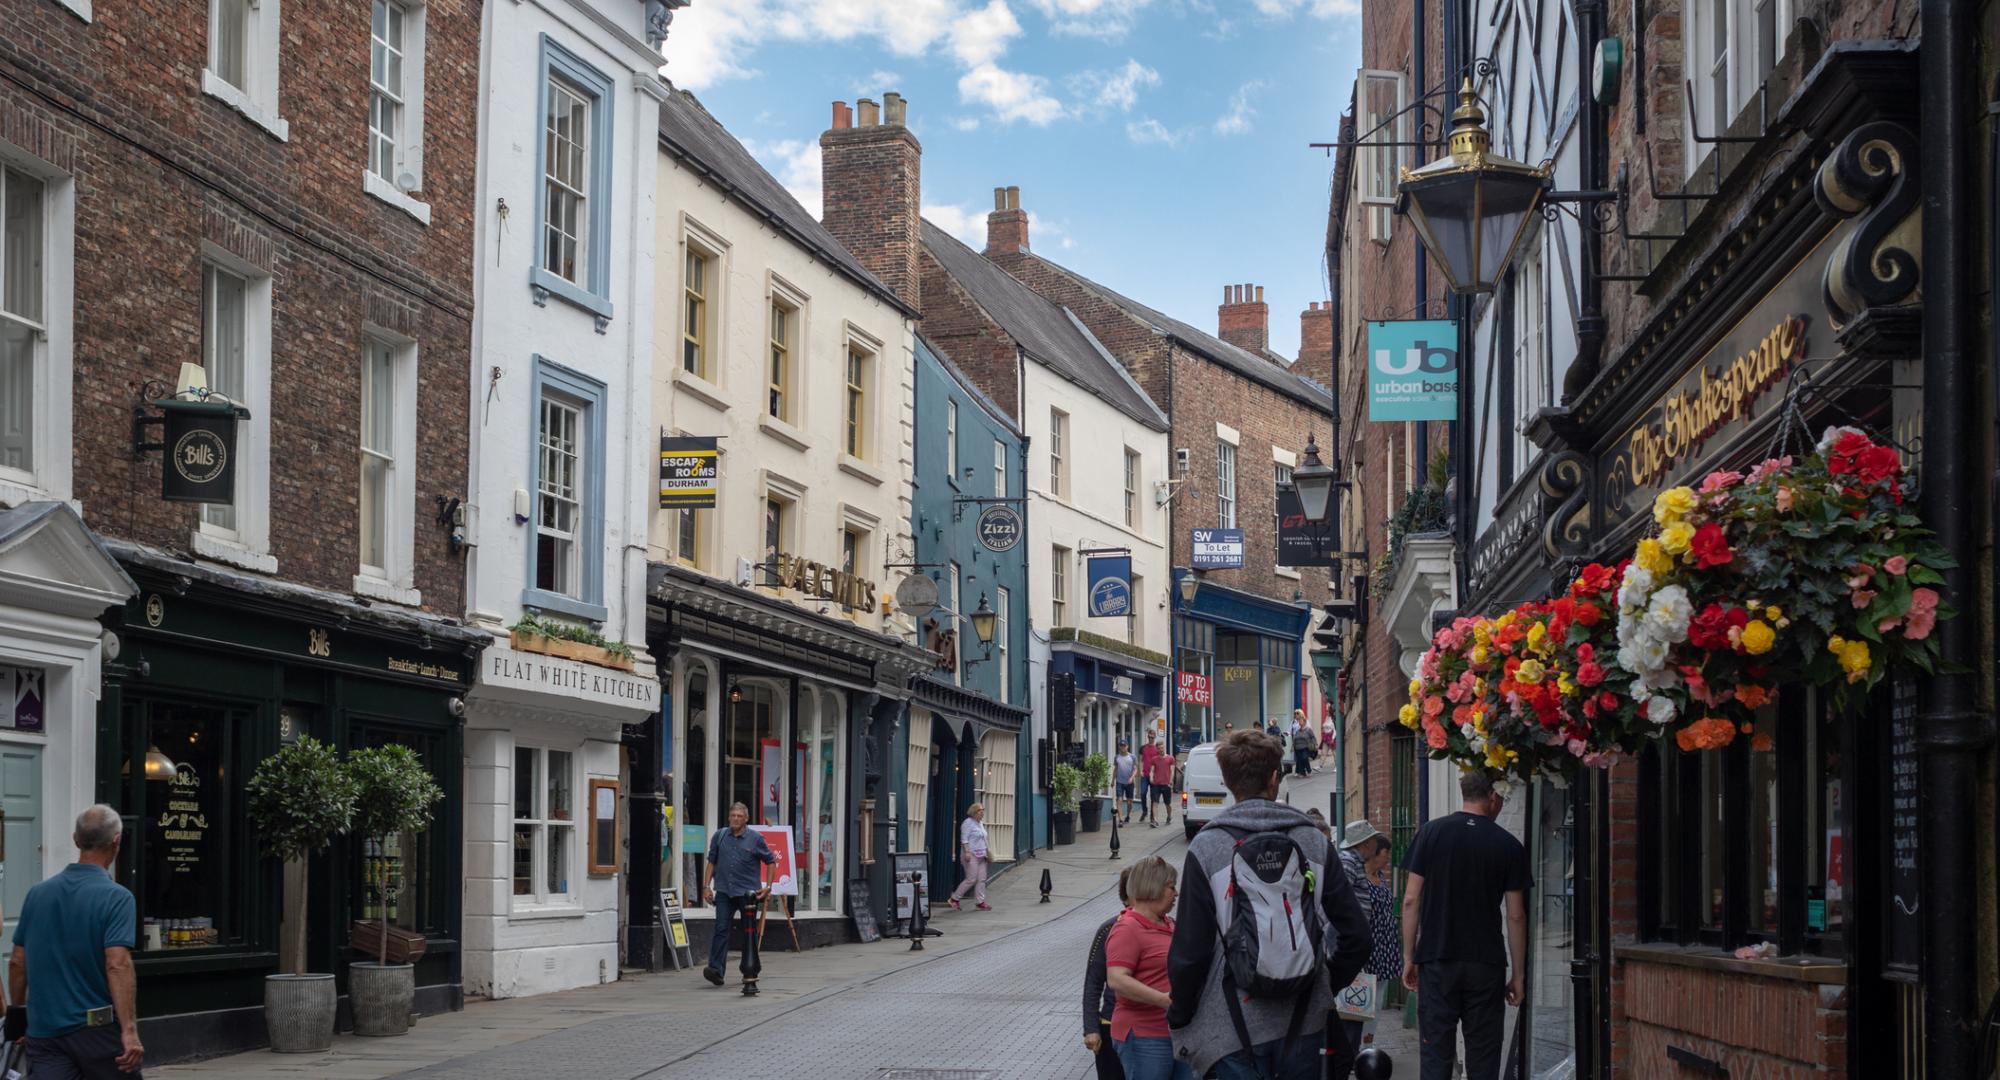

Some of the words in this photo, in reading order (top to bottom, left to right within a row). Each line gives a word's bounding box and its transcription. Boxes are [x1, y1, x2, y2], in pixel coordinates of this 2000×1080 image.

[1631, 423, 1664, 488] The
[1665, 313, 1797, 463] Shakespeare
[185, 444, 215, 466] Bill's
[662, 457, 706, 469] ESCAPE
[676, 467, 715, 477] ROOMS
[668, 480, 708, 488] DURHAM
[984, 523, 1016, 535] Zizzi
[1194, 531, 1213, 543] SW
[1205, 543, 1215, 552] To
[1216, 543, 1231, 552] Let
[1194, 555, 1211, 563] 0191
[1212, 555, 1224, 563] 261
[309, 628, 331, 657] Bill's
[493, 656, 533, 681] FLAT
[540, 665, 588, 691] WHITE
[593, 675, 653, 702] KITCHEN
[1181, 673, 1194, 687] UP
[1195, 675, 1206, 690] TO
